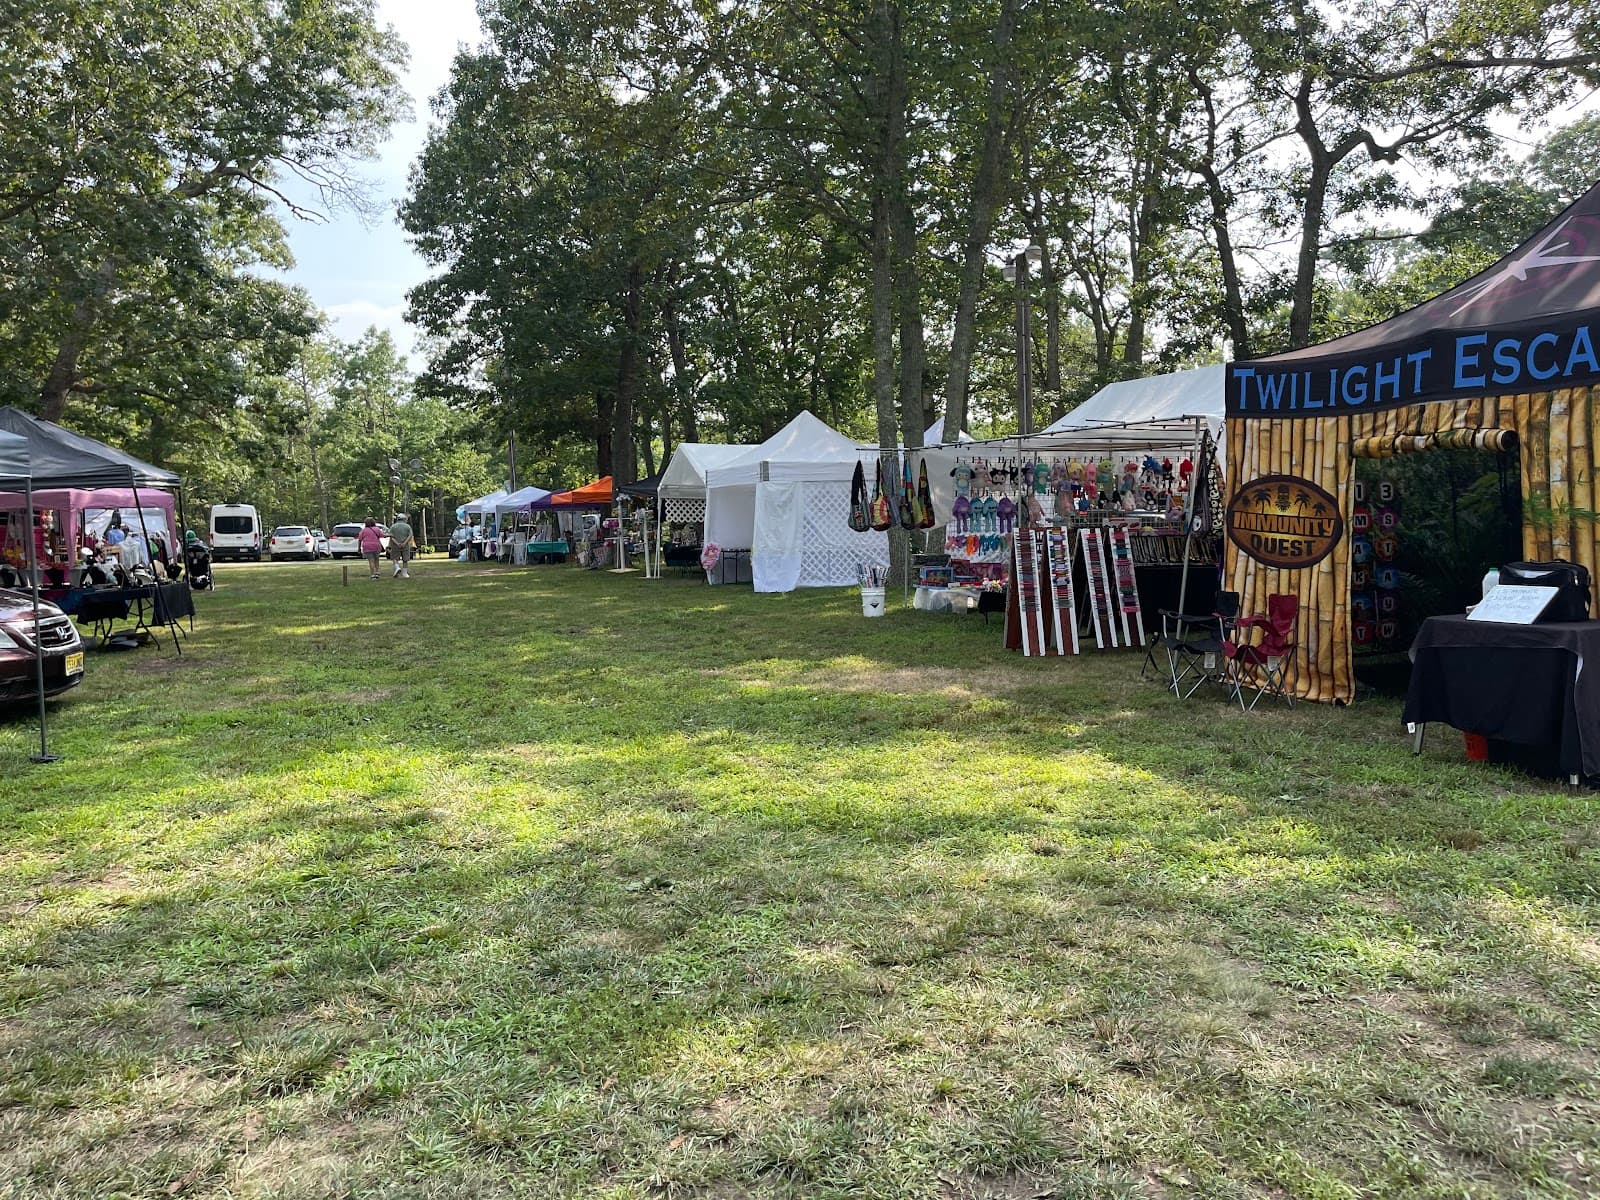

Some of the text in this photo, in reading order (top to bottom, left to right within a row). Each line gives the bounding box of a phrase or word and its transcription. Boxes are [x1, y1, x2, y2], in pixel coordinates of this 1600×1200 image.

[1233, 326, 1600, 410] TWILIGHT ESCA
[1381, 482, 1393, 500] 3
[1233, 511, 1335, 537] IMMUNITY
[1354, 513, 1393, 528] M S
[1251, 534, 1316, 556] QUEST
[1353, 542, 1363, 556] A
